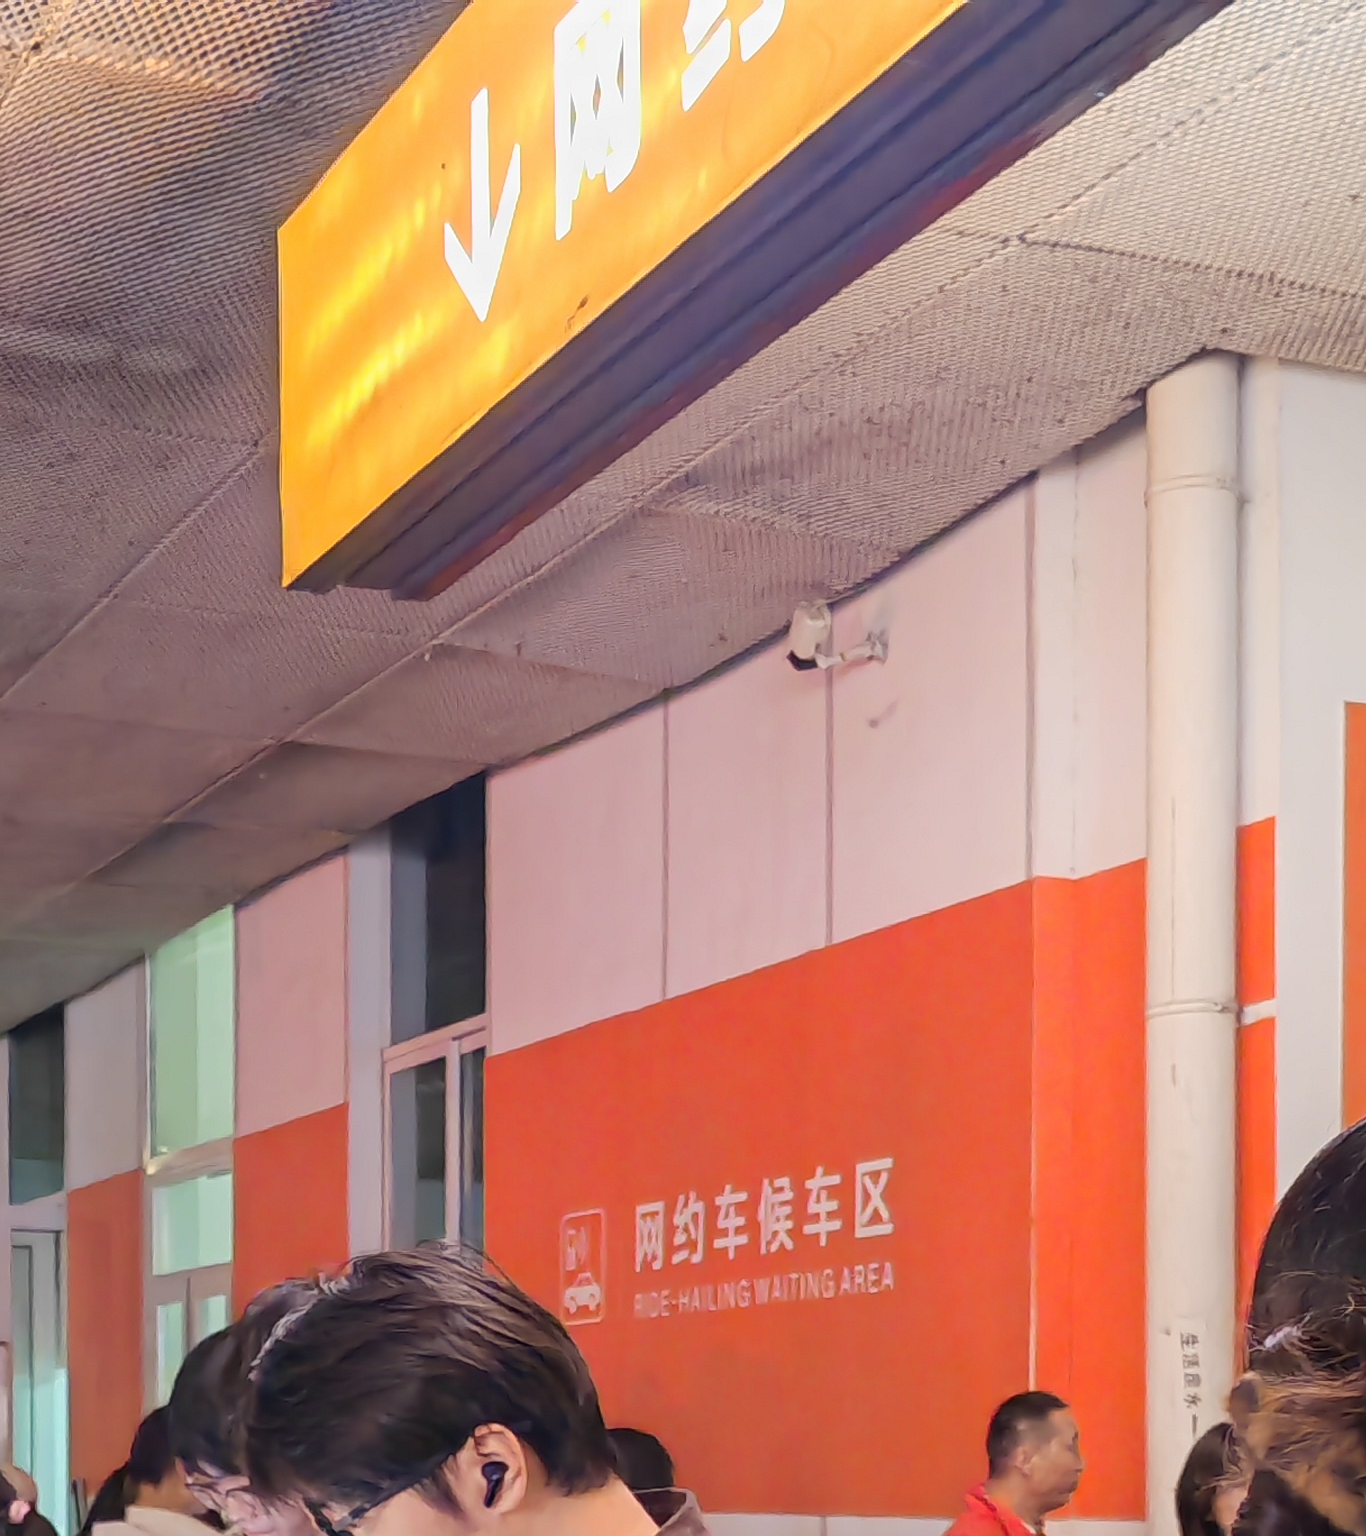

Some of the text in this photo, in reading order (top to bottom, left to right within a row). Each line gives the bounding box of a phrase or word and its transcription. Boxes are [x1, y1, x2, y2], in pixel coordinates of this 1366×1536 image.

[634, 1156, 895, 1273] 网约车候车区
[752, 1267, 836, 1306] WAITING
[838, 1260, 895, 1296] AREA
